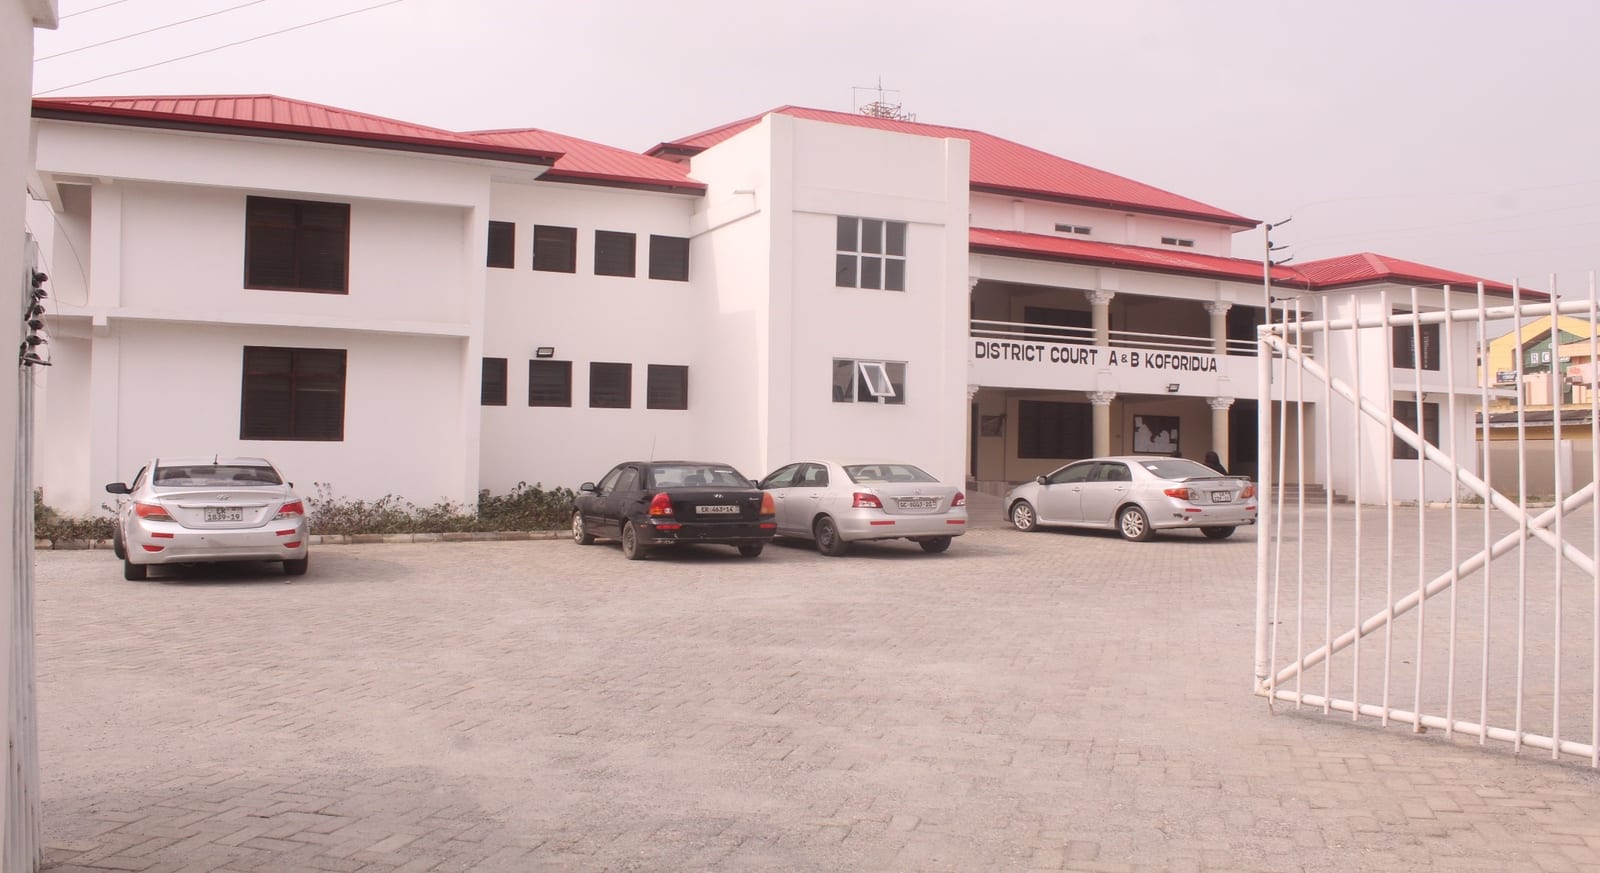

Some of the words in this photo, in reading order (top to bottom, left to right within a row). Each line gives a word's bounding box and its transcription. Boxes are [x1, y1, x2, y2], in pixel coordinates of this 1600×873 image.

[975, 341, 1045, 362] DISTRICT
[1050, 346, 1098, 365] COURT
[1145, 353, 1217, 372] KOFORIDUA
